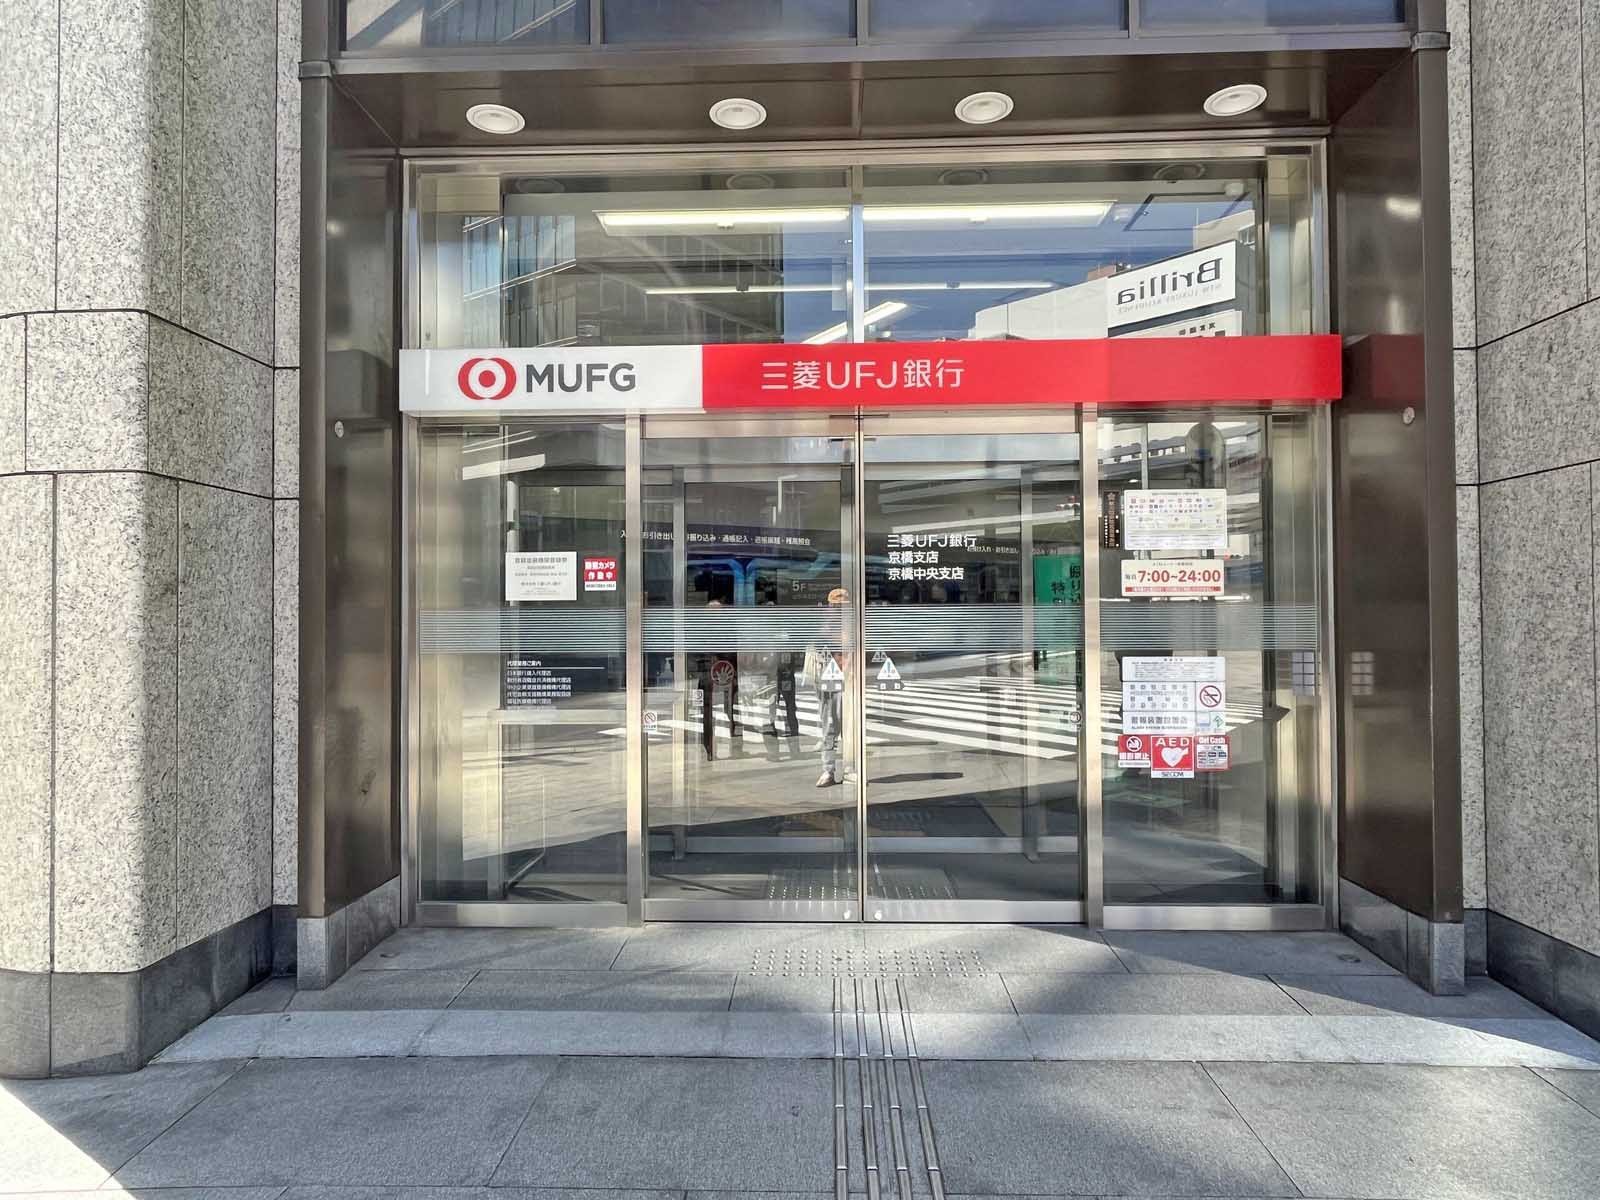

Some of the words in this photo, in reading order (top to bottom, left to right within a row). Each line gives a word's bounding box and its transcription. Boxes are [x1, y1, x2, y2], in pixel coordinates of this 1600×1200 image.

[525, 362, 637, 393] MUFG
[761, 358, 965, 390] 三菱UFJ銀行
[887, 534, 978, 548] 三菱UFJ銀行
[888, 551, 939, 564] 京橋支店
[584, 561, 616, 570] カメラ
[588, 571, 613, 580] 作中
[888, 567, 964, 581] 京橋中央支店
[1155, 737, 1190, 747] AED
